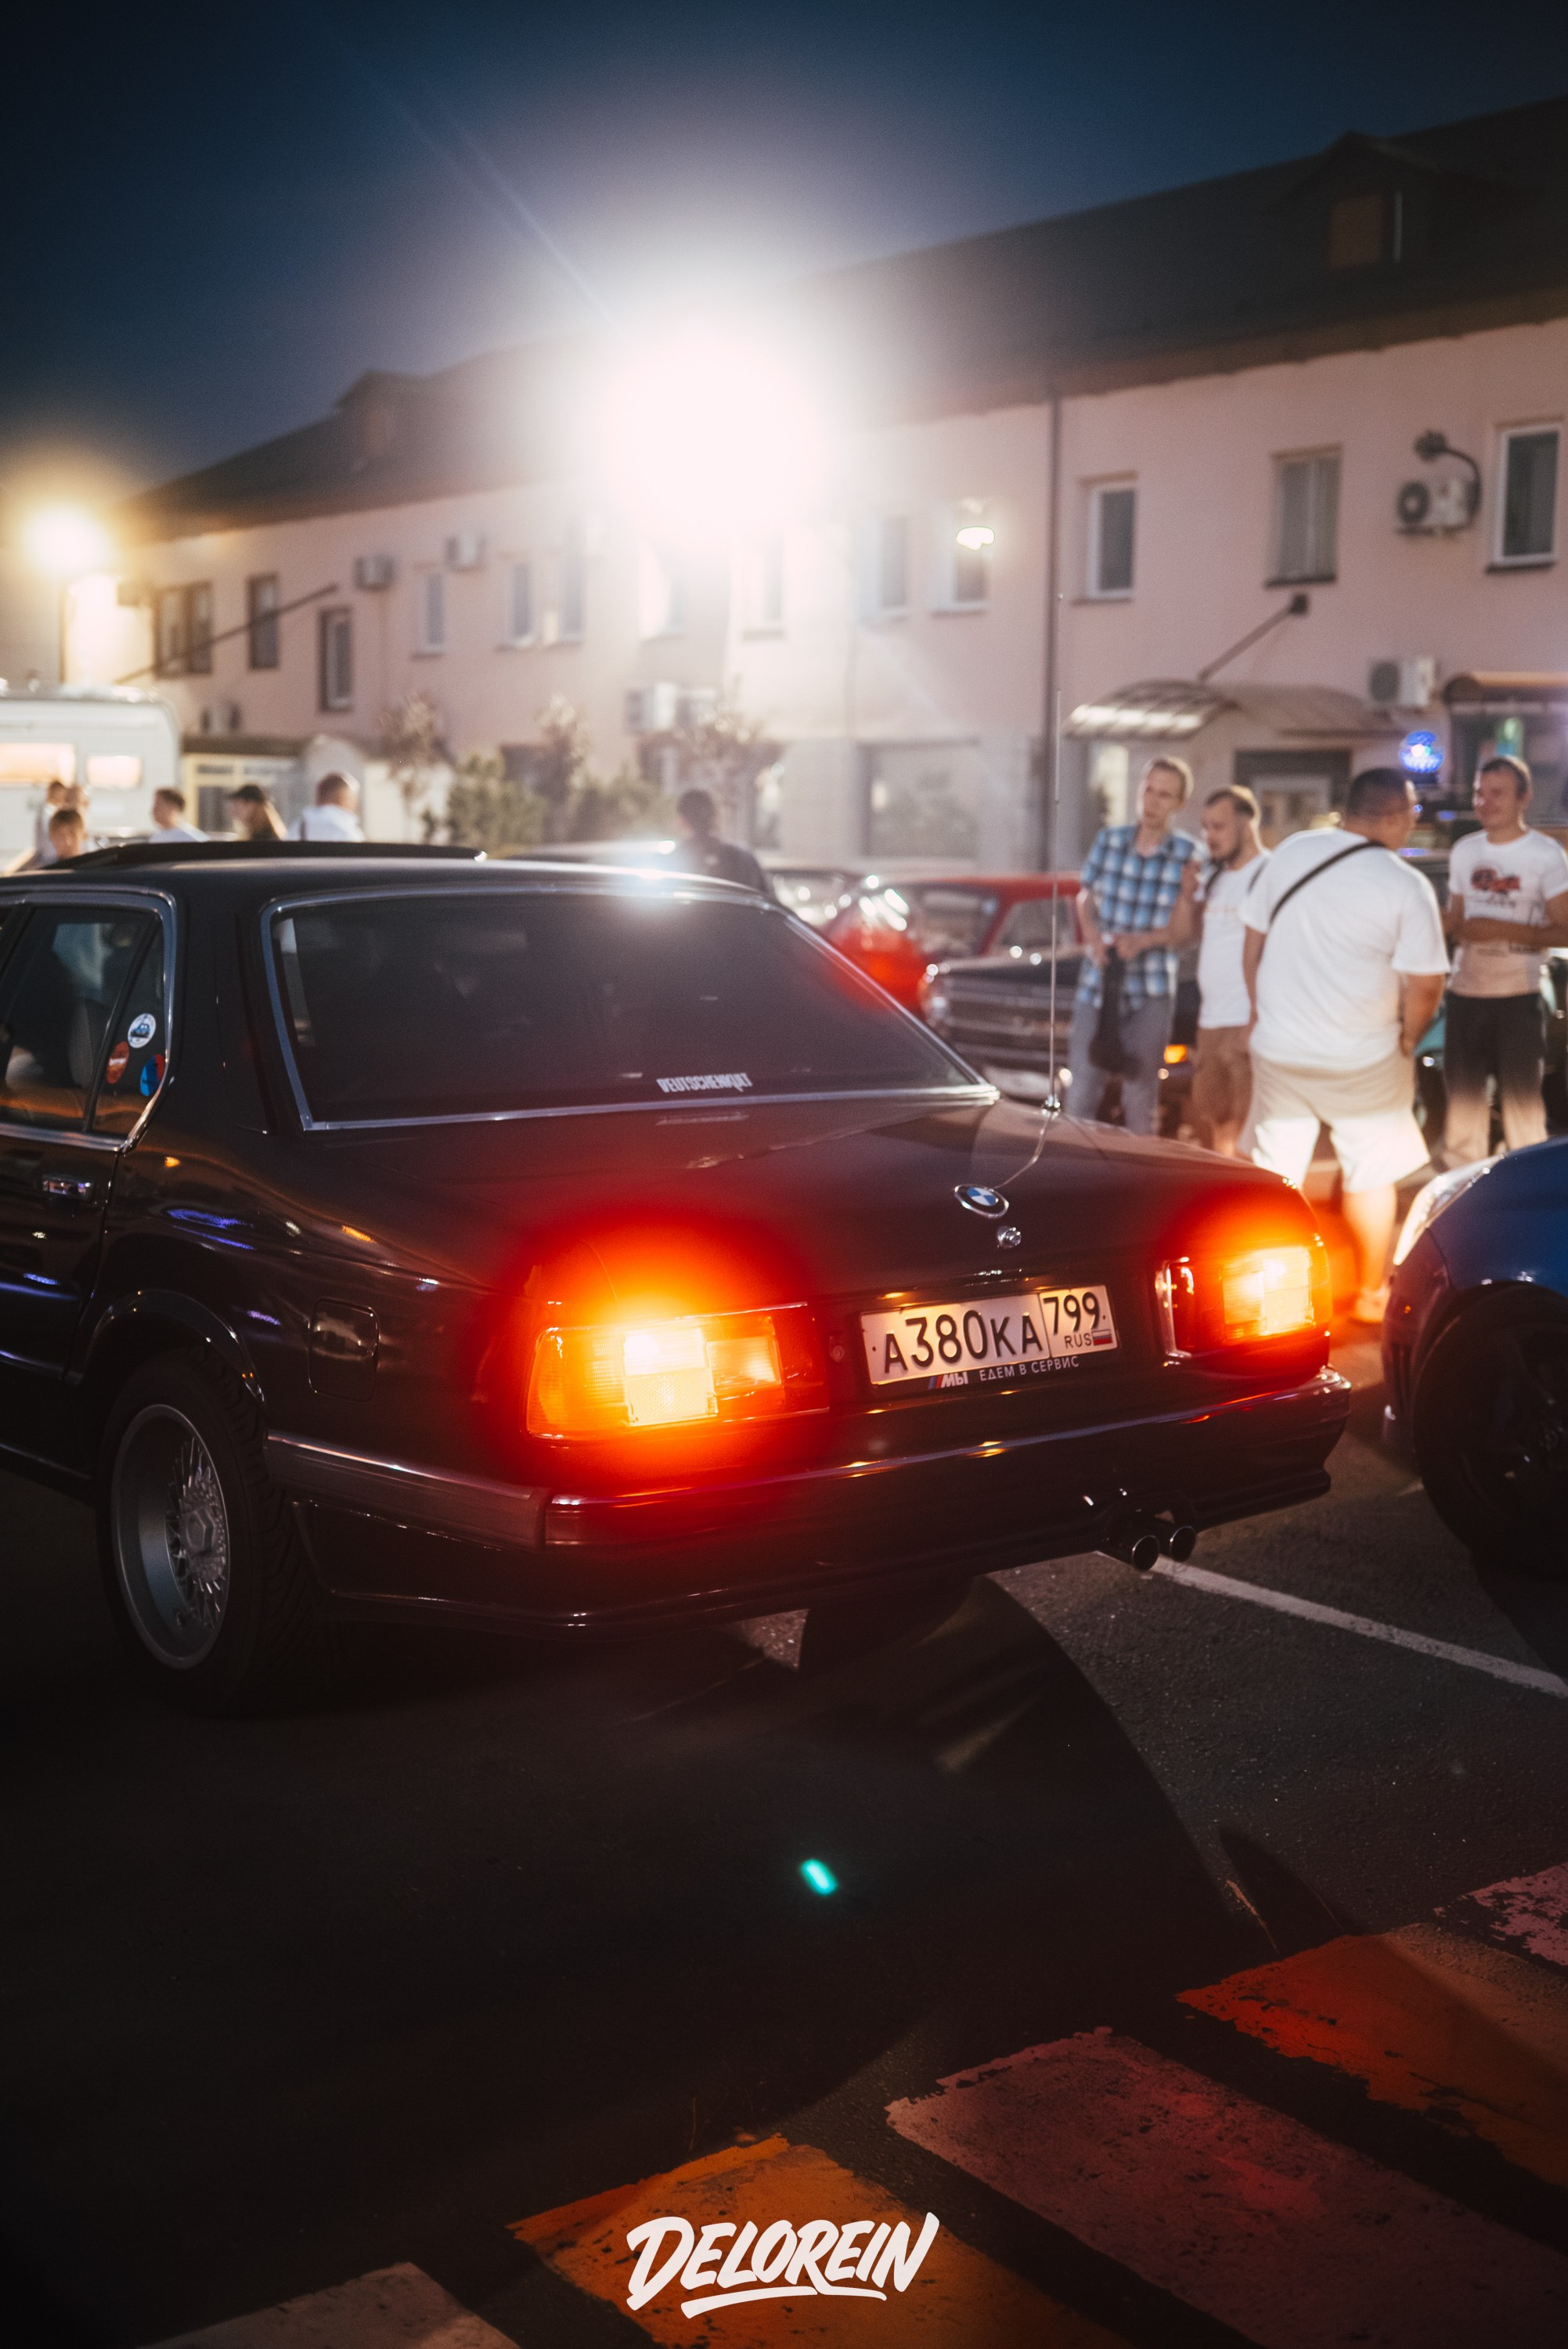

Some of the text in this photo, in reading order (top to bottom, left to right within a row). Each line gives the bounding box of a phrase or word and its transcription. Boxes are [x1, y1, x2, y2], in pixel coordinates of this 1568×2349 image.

[883, 1291, 1100, 1373] А380КА 799
[1064, 1333, 1092, 1349] RUS
[940, 1355, 1080, 1388] МЫ ЕДЕМ В СЕРВИС
